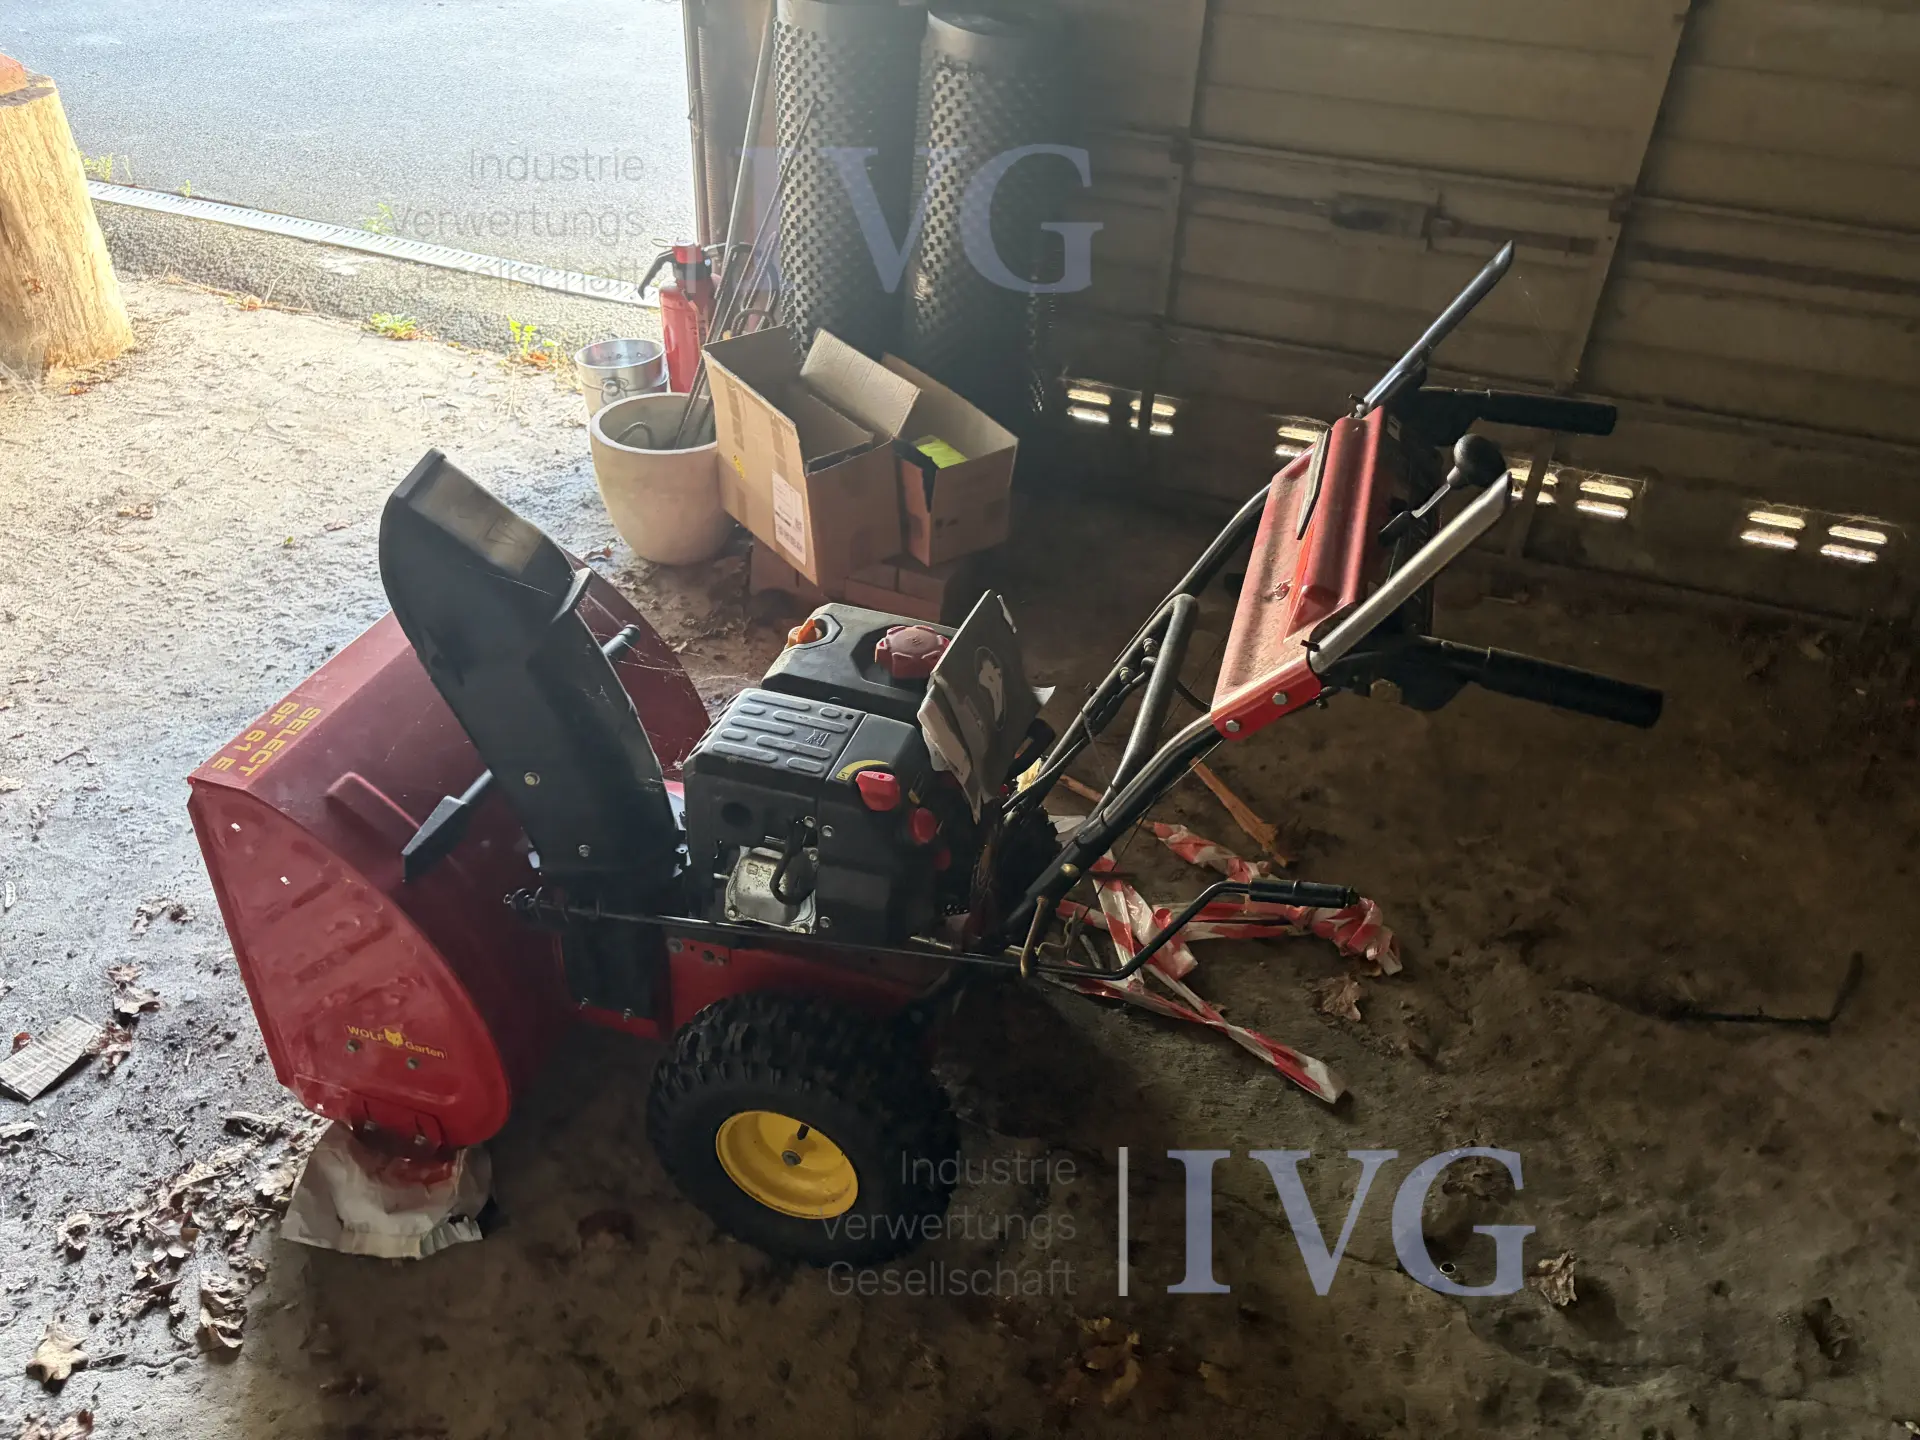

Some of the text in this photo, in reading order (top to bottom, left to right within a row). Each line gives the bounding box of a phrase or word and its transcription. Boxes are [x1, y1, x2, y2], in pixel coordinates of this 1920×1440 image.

[212, 702, 299, 771] SF 61 E
[239, 707, 321, 776] SELECT
[346, 1025, 445, 1059] WOLF Garten
